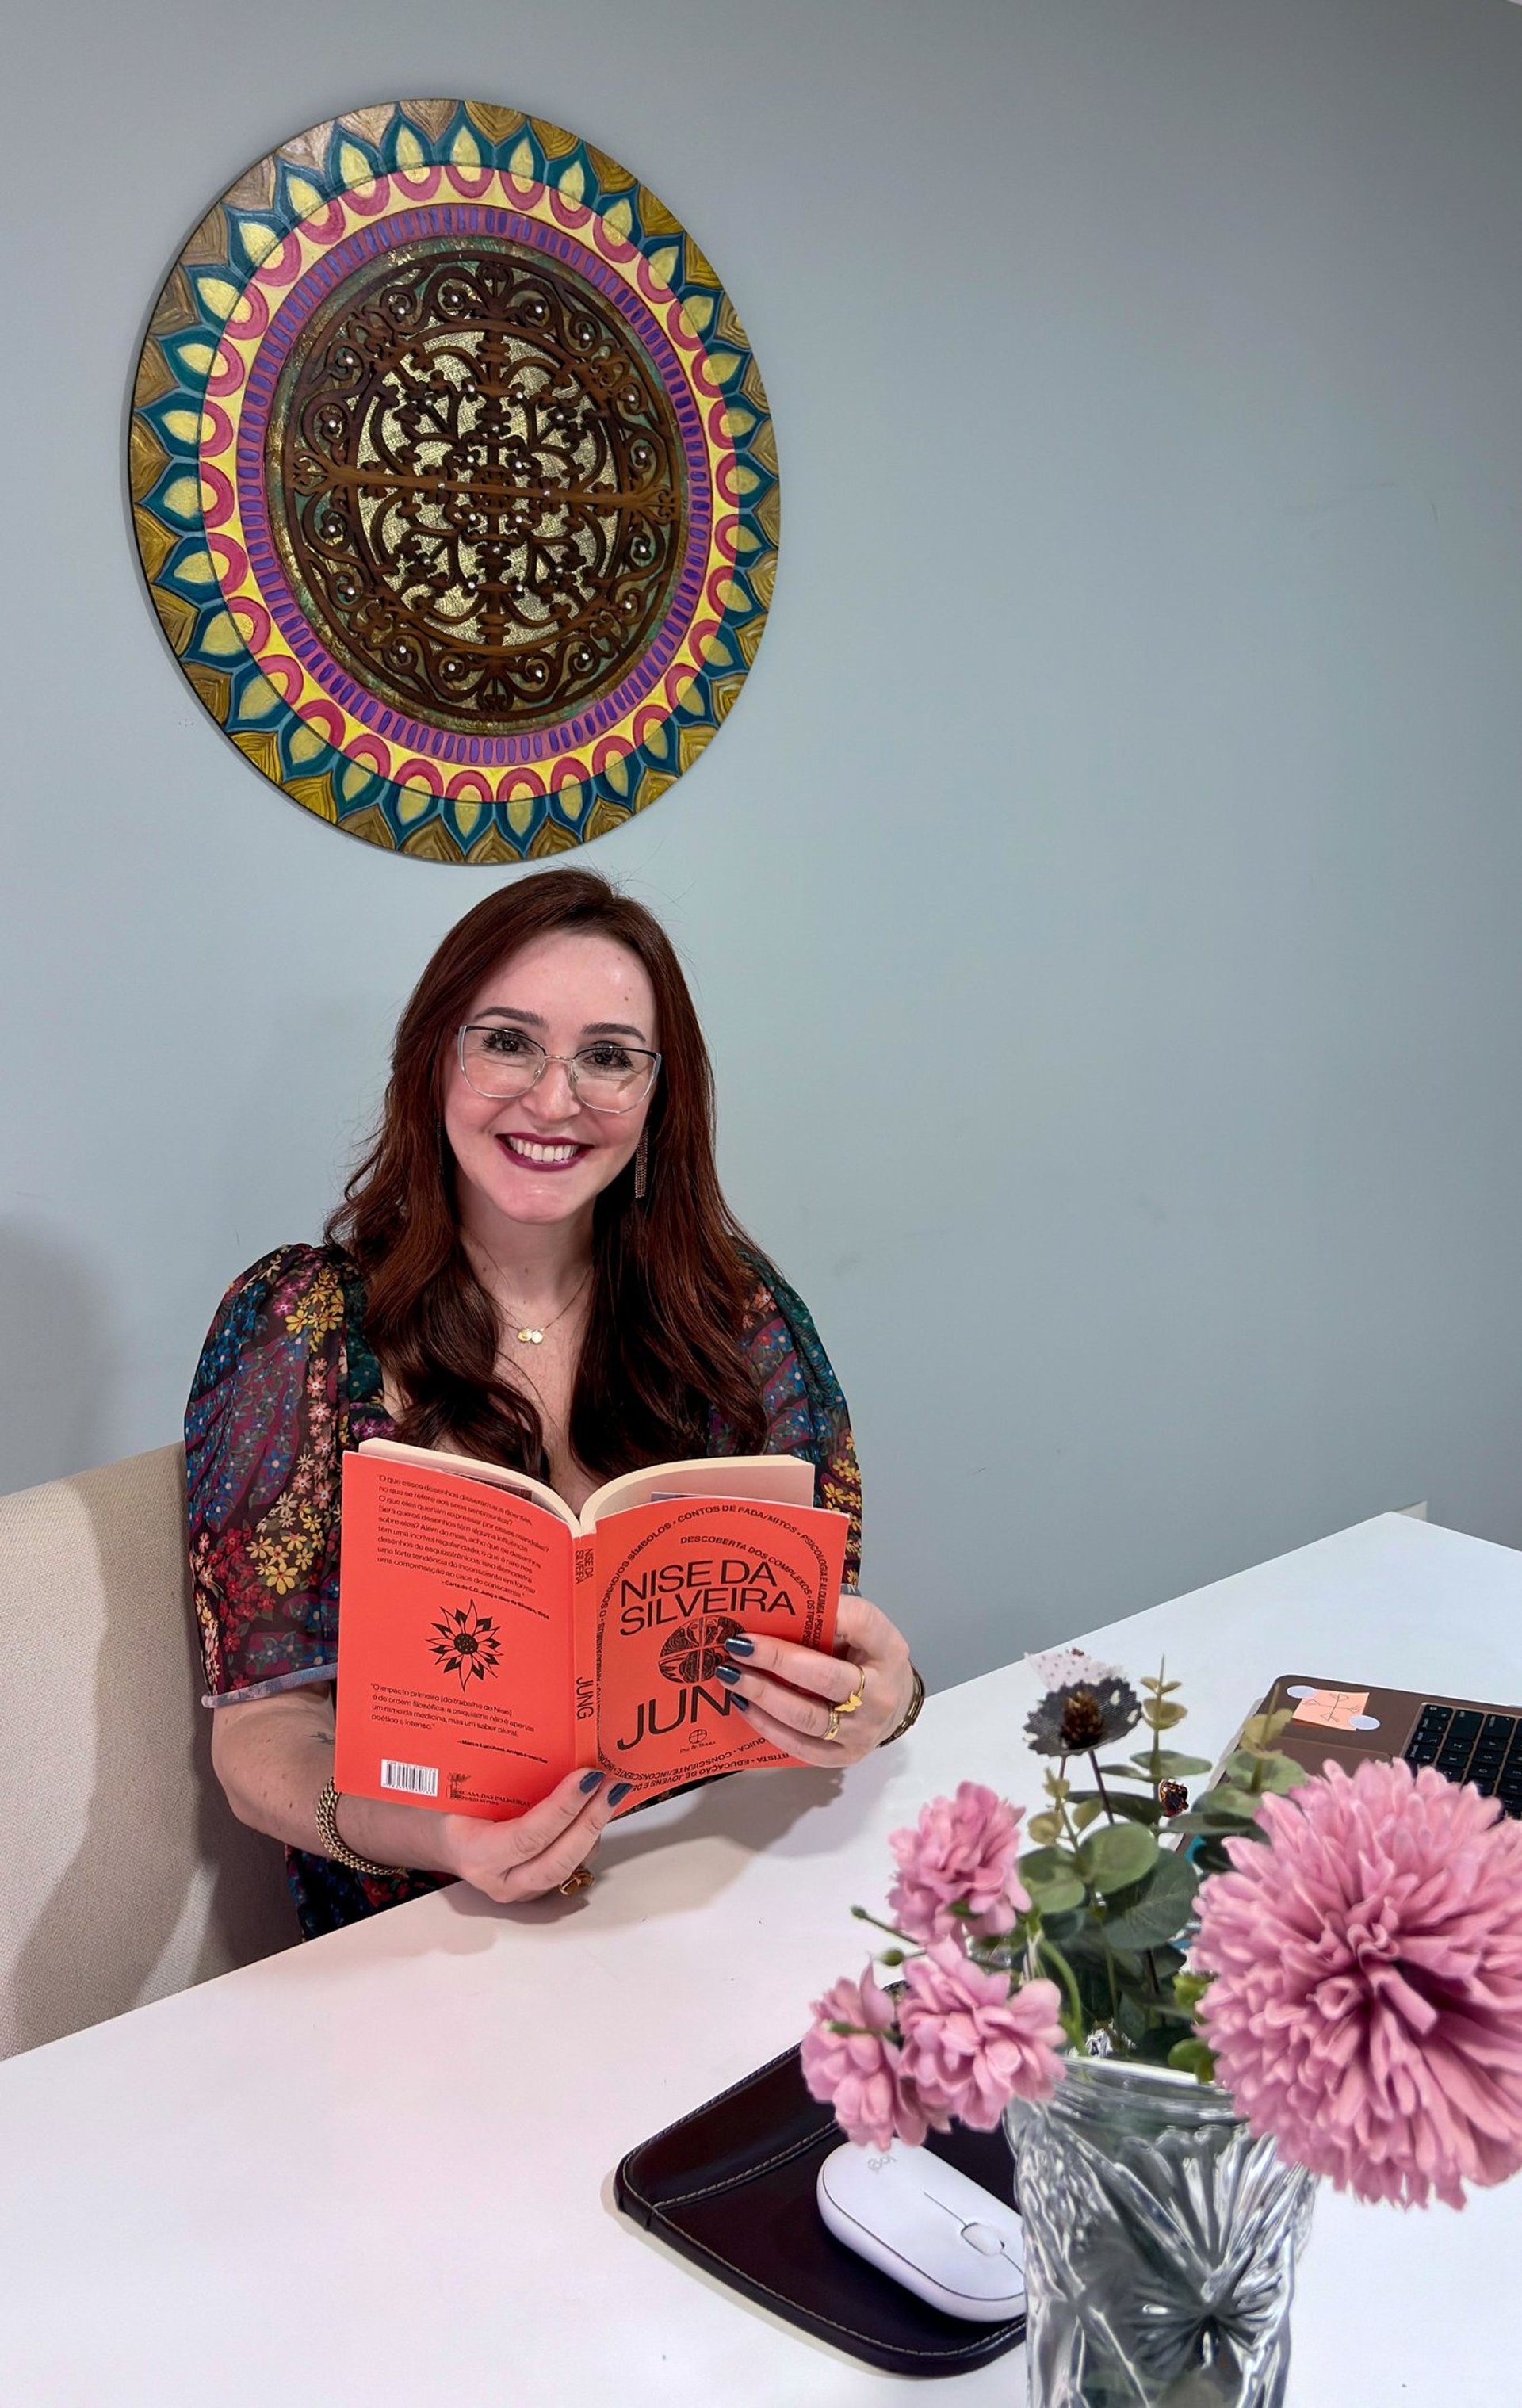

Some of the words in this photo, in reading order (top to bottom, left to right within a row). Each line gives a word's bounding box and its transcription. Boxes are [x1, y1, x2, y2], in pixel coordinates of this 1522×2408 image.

[389, 1488, 403, 1496] que
[414, 1492, 435, 1503] refere
[424, 1485, 459, 1499] desenhos
[401, 1500, 417, 1509] eles
[417, 1504, 446, 1516] queriam
[421, 1514, 456, 1528] desenhos
[378, 1516, 400, 1525] sobre
[468, 1536, 486, 1546] acho
[486, 1541, 500, 1551] que
[575, 1550, 584, 1584] SILVEIRA
[585, 1548, 594, 1568] NISE
[677, 1505, 721, 1523] CONTOS
[737, 1505, 797, 1534] FADA/MITOS
[800, 1534, 828, 1577] PSICOLOGIA
[816, 1583, 828, 1615] ALQUIMIA
[585, 1568, 594, 1580] DA
[621, 1560, 713, 1608] NISE
[721, 1559, 778, 1587] DA
[680, 1535, 747, 1550] DESCOBERTA
[748, 1546, 769, 1560] DOS
[767, 1555, 813, 1596] COMPLEXOS
[805, 1600, 815, 1610] OS
[619, 1586, 797, 1637] SILVEIRA
[380, 1686, 410, 1696] impacto
[410, 1690, 440, 1702] primeiro
[453, 1698, 483, 1710] trabalho
[576, 1676, 595, 1721] JUNG
[371, 1714, 399, 1725] poético
[384, 1706, 403, 1715] ramo
[476, 1722, 498, 1733] saber
[388, 1697, 412, 1707] ordem
[489, 1714, 503, 1724] não
[616, 1684, 734, 1751] JUN
[738, 1737, 767, 1752] QUICA
[615, 1752, 732, 1781] CONSCIENTE/INCONSCIENTE
[698, 1758, 750, 1779] EDUCAÇÃO
[756, 1752, 790, 1764] RTISTA
[650, 1772, 685, 1789] JOVENS
[685, 1769, 698, 1779] DE
